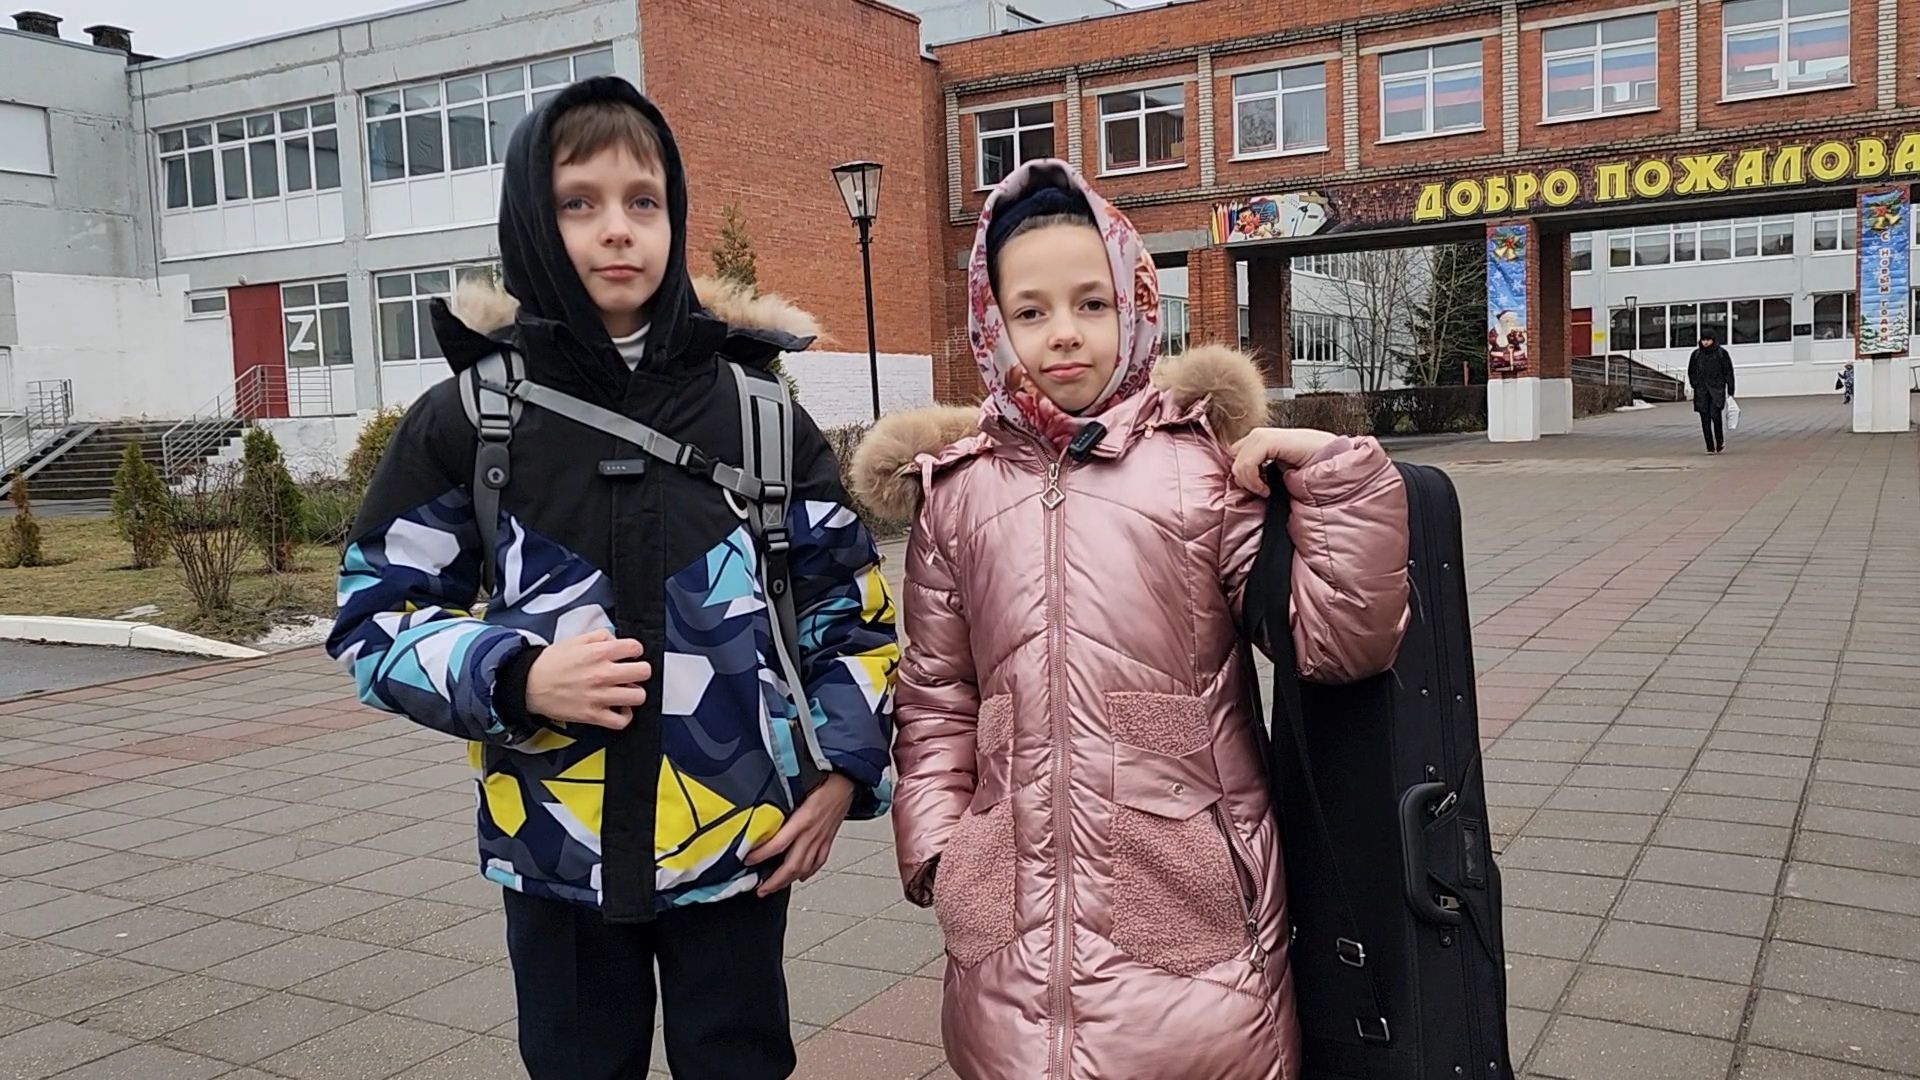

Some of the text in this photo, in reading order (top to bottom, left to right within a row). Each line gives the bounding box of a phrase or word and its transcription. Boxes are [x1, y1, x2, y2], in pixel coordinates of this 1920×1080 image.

[1413, 132, 1920, 223] ДОБРО ПОЖАЛОВА
[1880, 231, 1890, 342] С НОВЫМ ГОДОМ
[287, 314, 316, 352] Z
